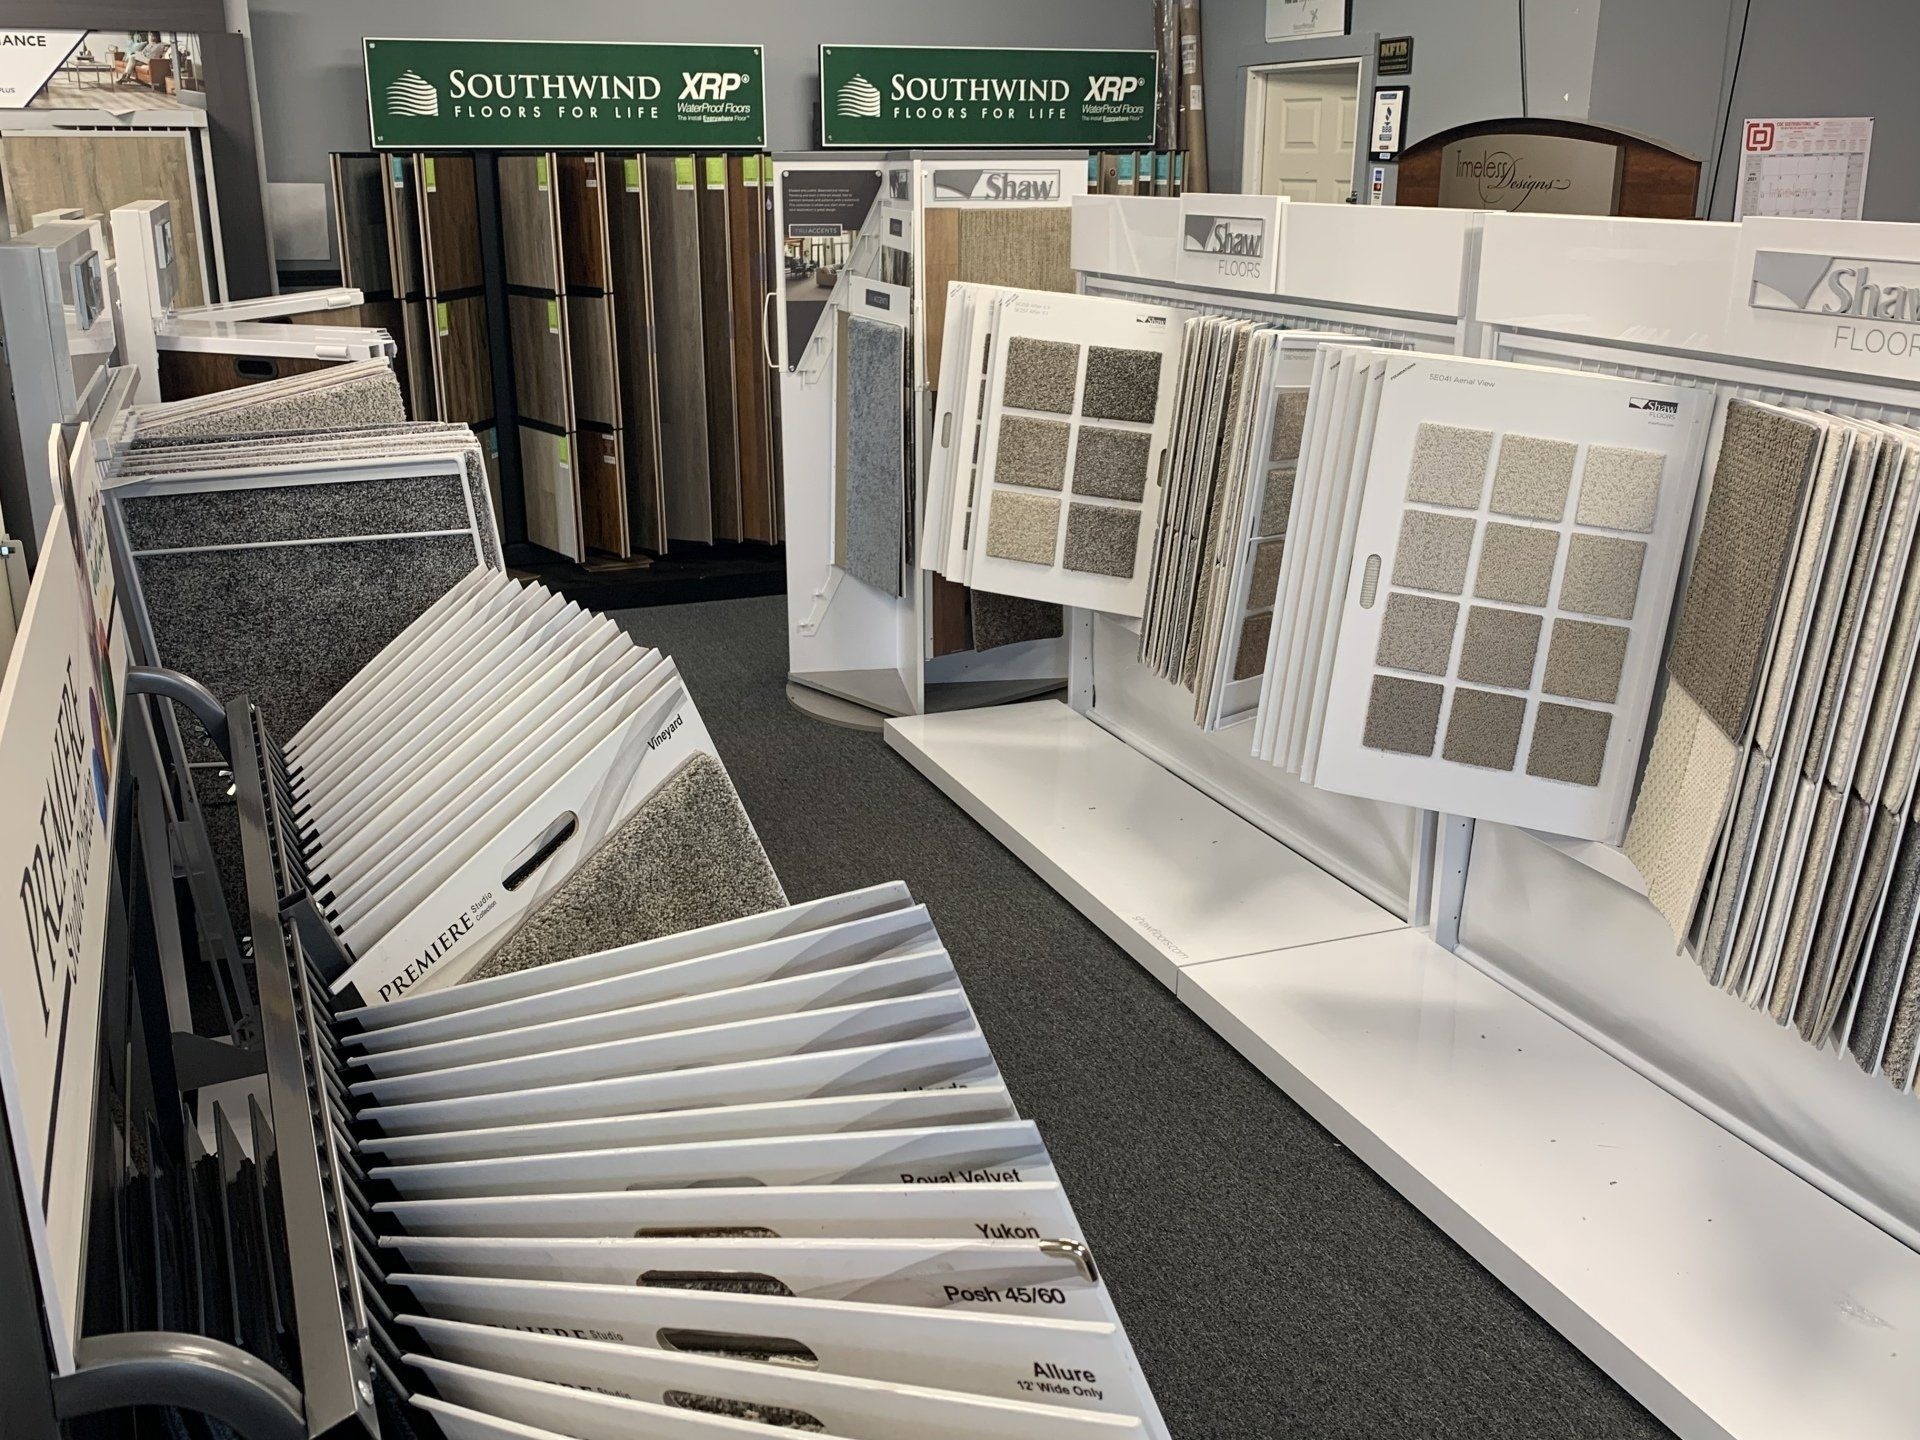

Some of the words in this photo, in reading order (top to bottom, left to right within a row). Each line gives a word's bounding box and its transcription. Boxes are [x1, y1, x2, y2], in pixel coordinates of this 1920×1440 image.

[0, 35, 47, 47] ANCE
[449, 69, 661, 100] SOUTHWIND
[891, 73, 1070, 102] SOUTHWIND
[454, 105, 542, 118] FLOORS
[558, 106, 599, 119] FOR
[615, 106, 659, 119] LIFE
[677, 102, 724, 113] WaterProof
[725, 103, 751, 113] Floors
[893, 107, 968, 119] FLOORS
[981, 108, 1015, 119] FOR
[1029, 108, 1066, 119] LIFE
[1082, 104, 1121, 114] WaterProof
[1122, 104, 1145, 114] Floors
[1455, 150, 1509, 179] Timeless
[984, 173, 1054, 200] Shaw
[1487, 159, 1571, 211] Designs
[1213, 222, 1263, 257] Shaw
[1218, 259, 1262, 279] FLOORS
[1453, 375, 1475, 386] Aerial
[1477, 378, 1496, 388] View
[1648, 401, 1677, 414] Shaw
[647, 713, 683, 751] Vineyard
[19, 653, 85, 1039] PREMIERE
[470, 891, 493, 914] Studio
[475, 900, 497, 922] Collection
[377, 912, 474, 1003] PREMIERE
[959, 1168, 1022, 1183] Velvet
[975, 1223, 1040, 1239] Yukon
[943, 1285, 1002, 1303] Posh
[1005, 1287, 1066, 1304] 45/60
[588, 1329, 625, 1342] Studio
[1033, 1362, 1097, 1384] Allure
[1037, 1381, 1070, 1396] Wide
[1073, 1385, 1104, 1401] Only
